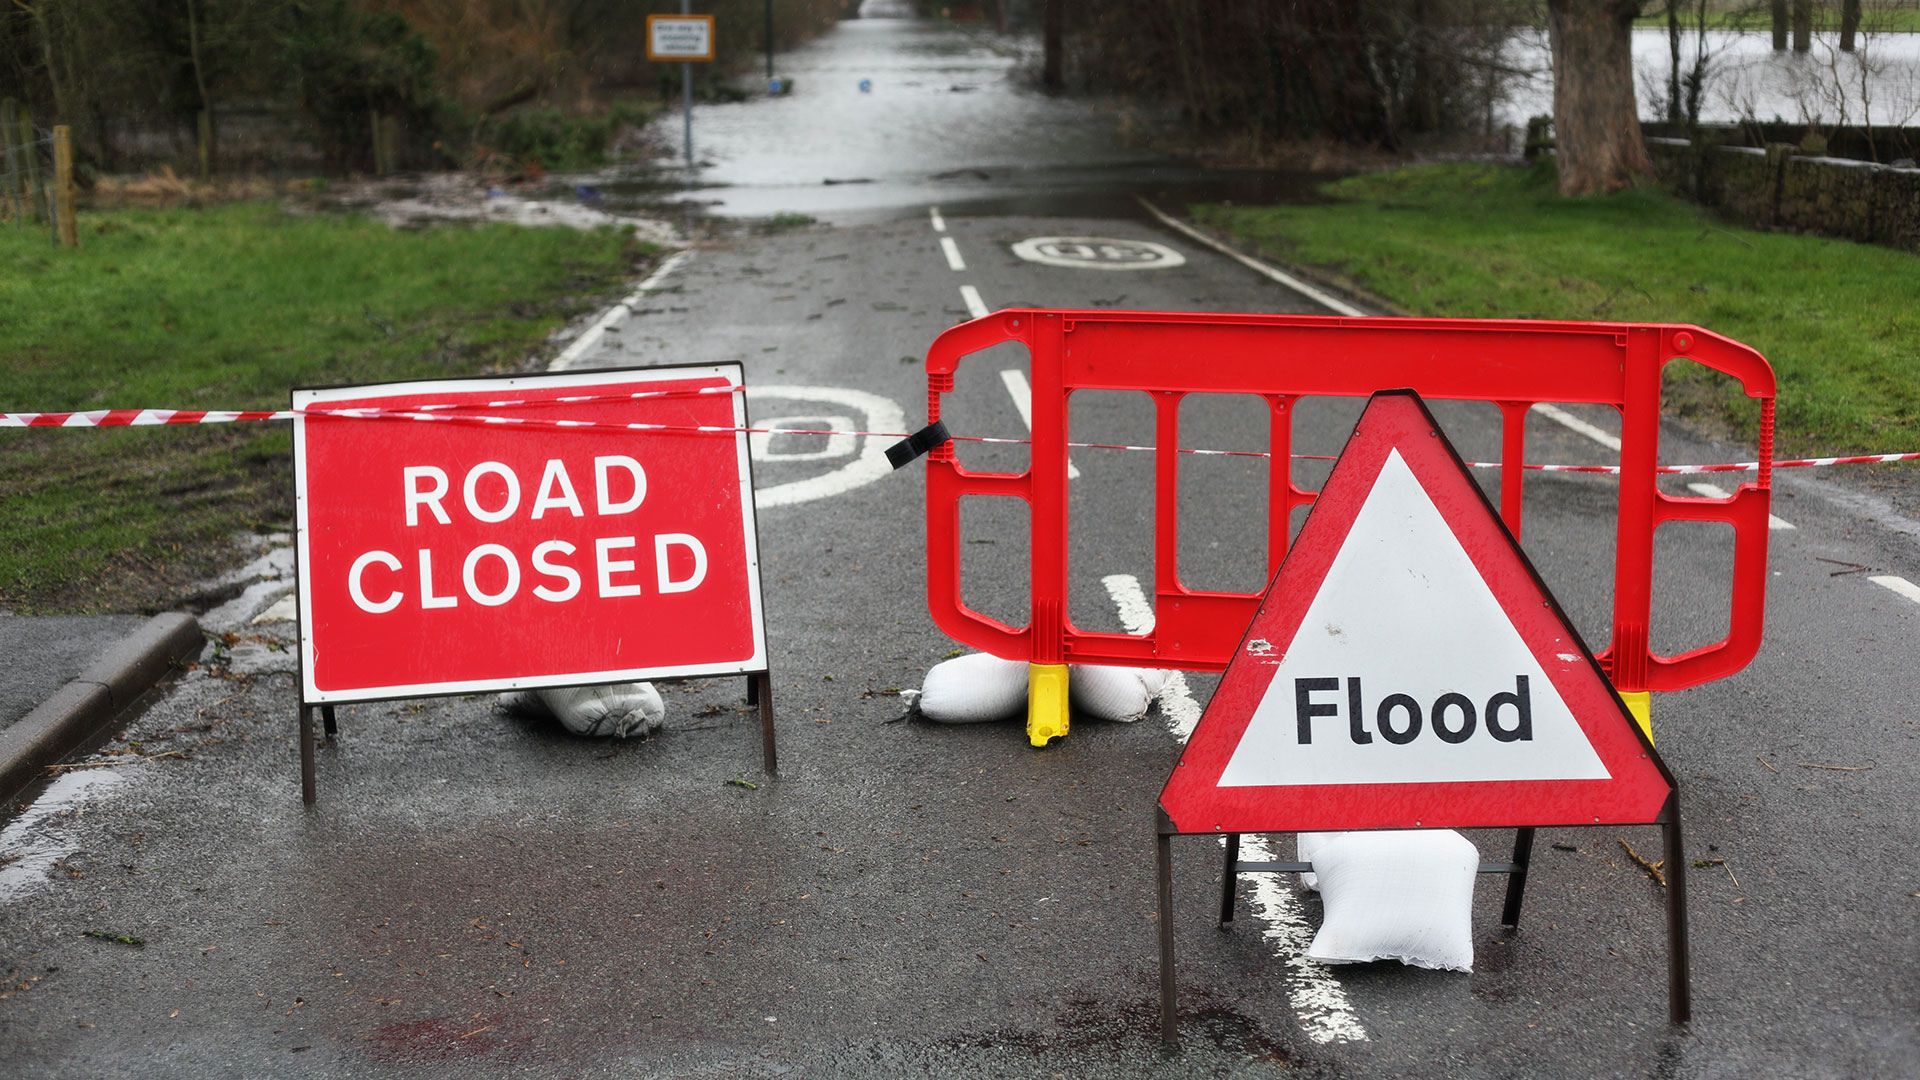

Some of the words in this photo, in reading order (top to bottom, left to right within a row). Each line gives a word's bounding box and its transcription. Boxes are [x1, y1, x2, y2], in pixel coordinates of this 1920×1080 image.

[404, 455, 647, 526] ROAD
[349, 533, 707, 613] CLOSED
[1295, 675, 1532, 745] Flood
